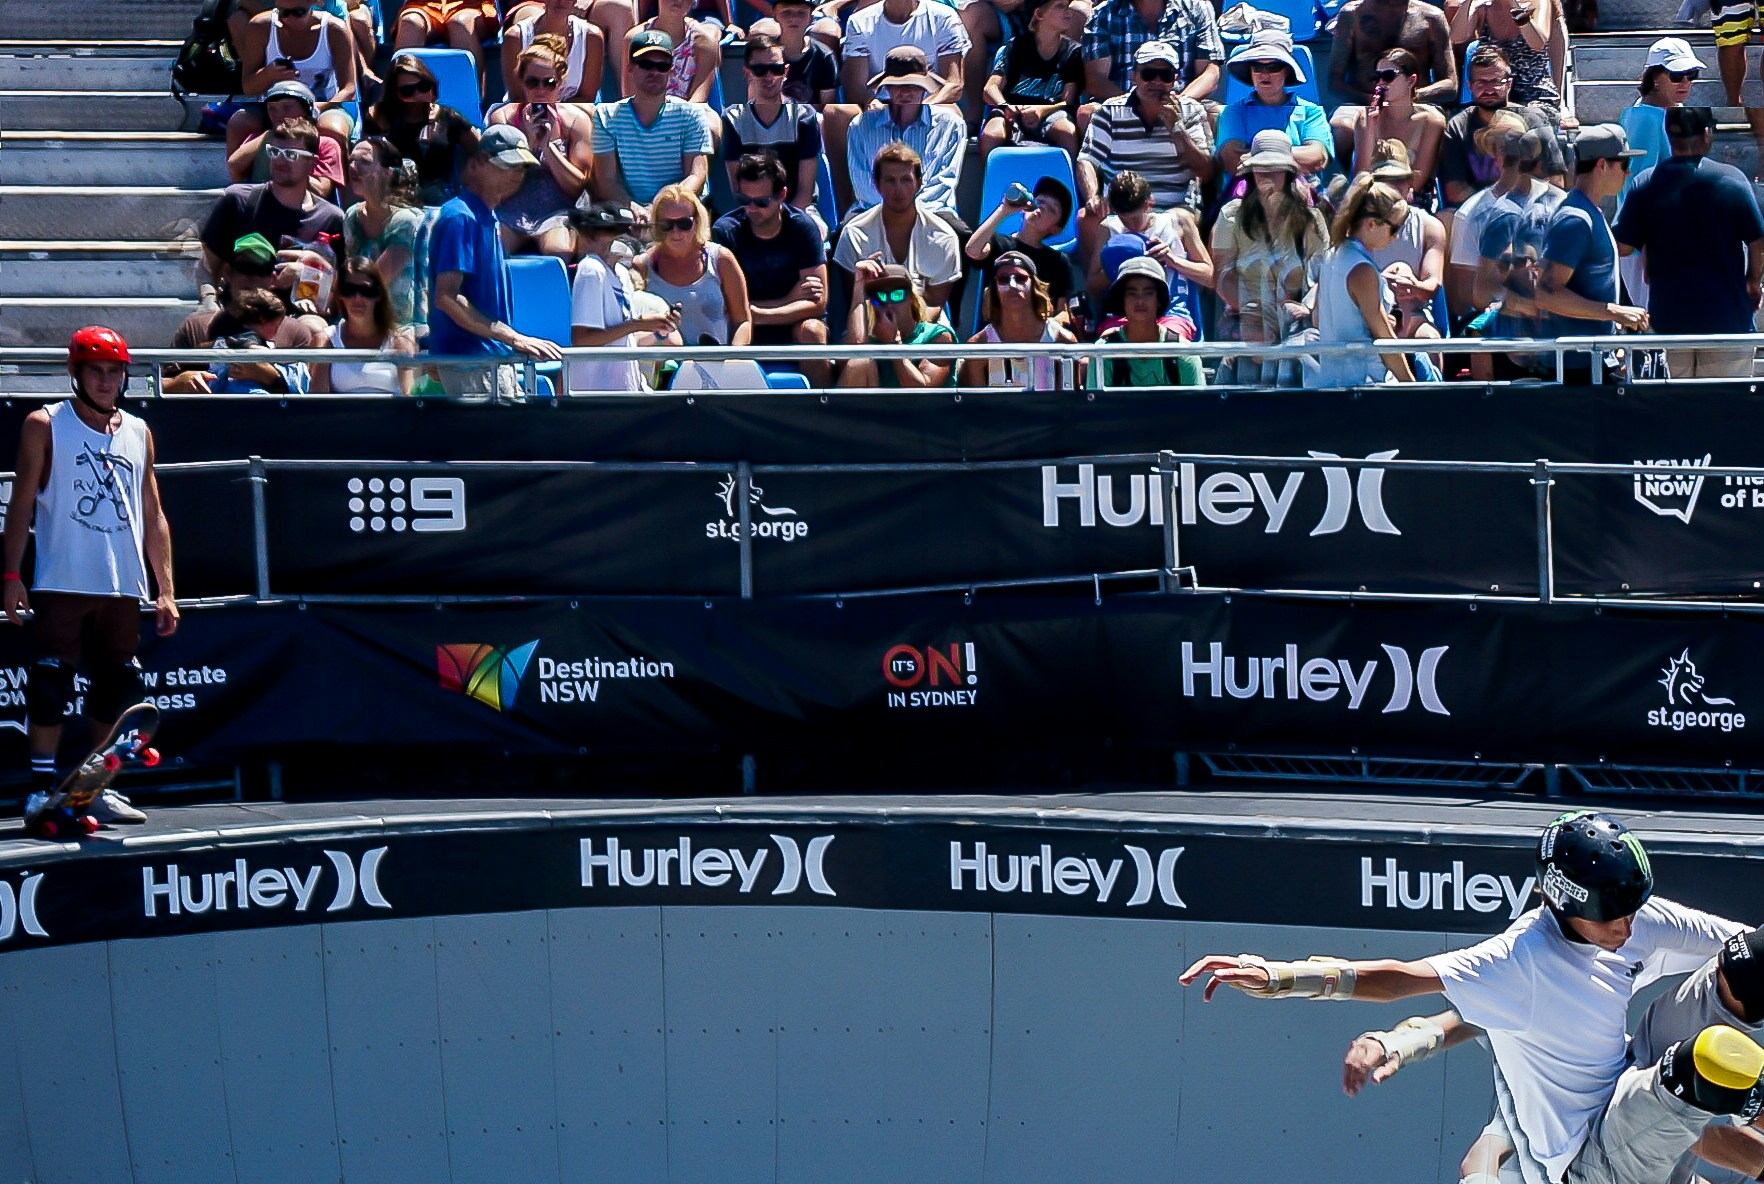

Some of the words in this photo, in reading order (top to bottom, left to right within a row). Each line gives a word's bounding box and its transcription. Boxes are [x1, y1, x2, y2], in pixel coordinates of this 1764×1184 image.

[1645, 481, 1695, 496] NOW
[1720, 489, 1747, 508] of
[165, 665, 227, 687] state
[539, 657, 674, 679] Destination
[892, 660, 915, 673] IT'S
[1182, 642, 1378, 709] Hurley
[540, 680, 600, 703] NSW
[888, 691, 906, 707] IN
[910, 689, 977, 707] SYDNEY
[1647, 706, 1746, 732] st.george
[580, 837, 769, 892] Hurley
[951, 841, 1123, 902] Hurley
[143, 859, 322, 916] Hurley
[1362, 857, 1537, 919] Hurley
